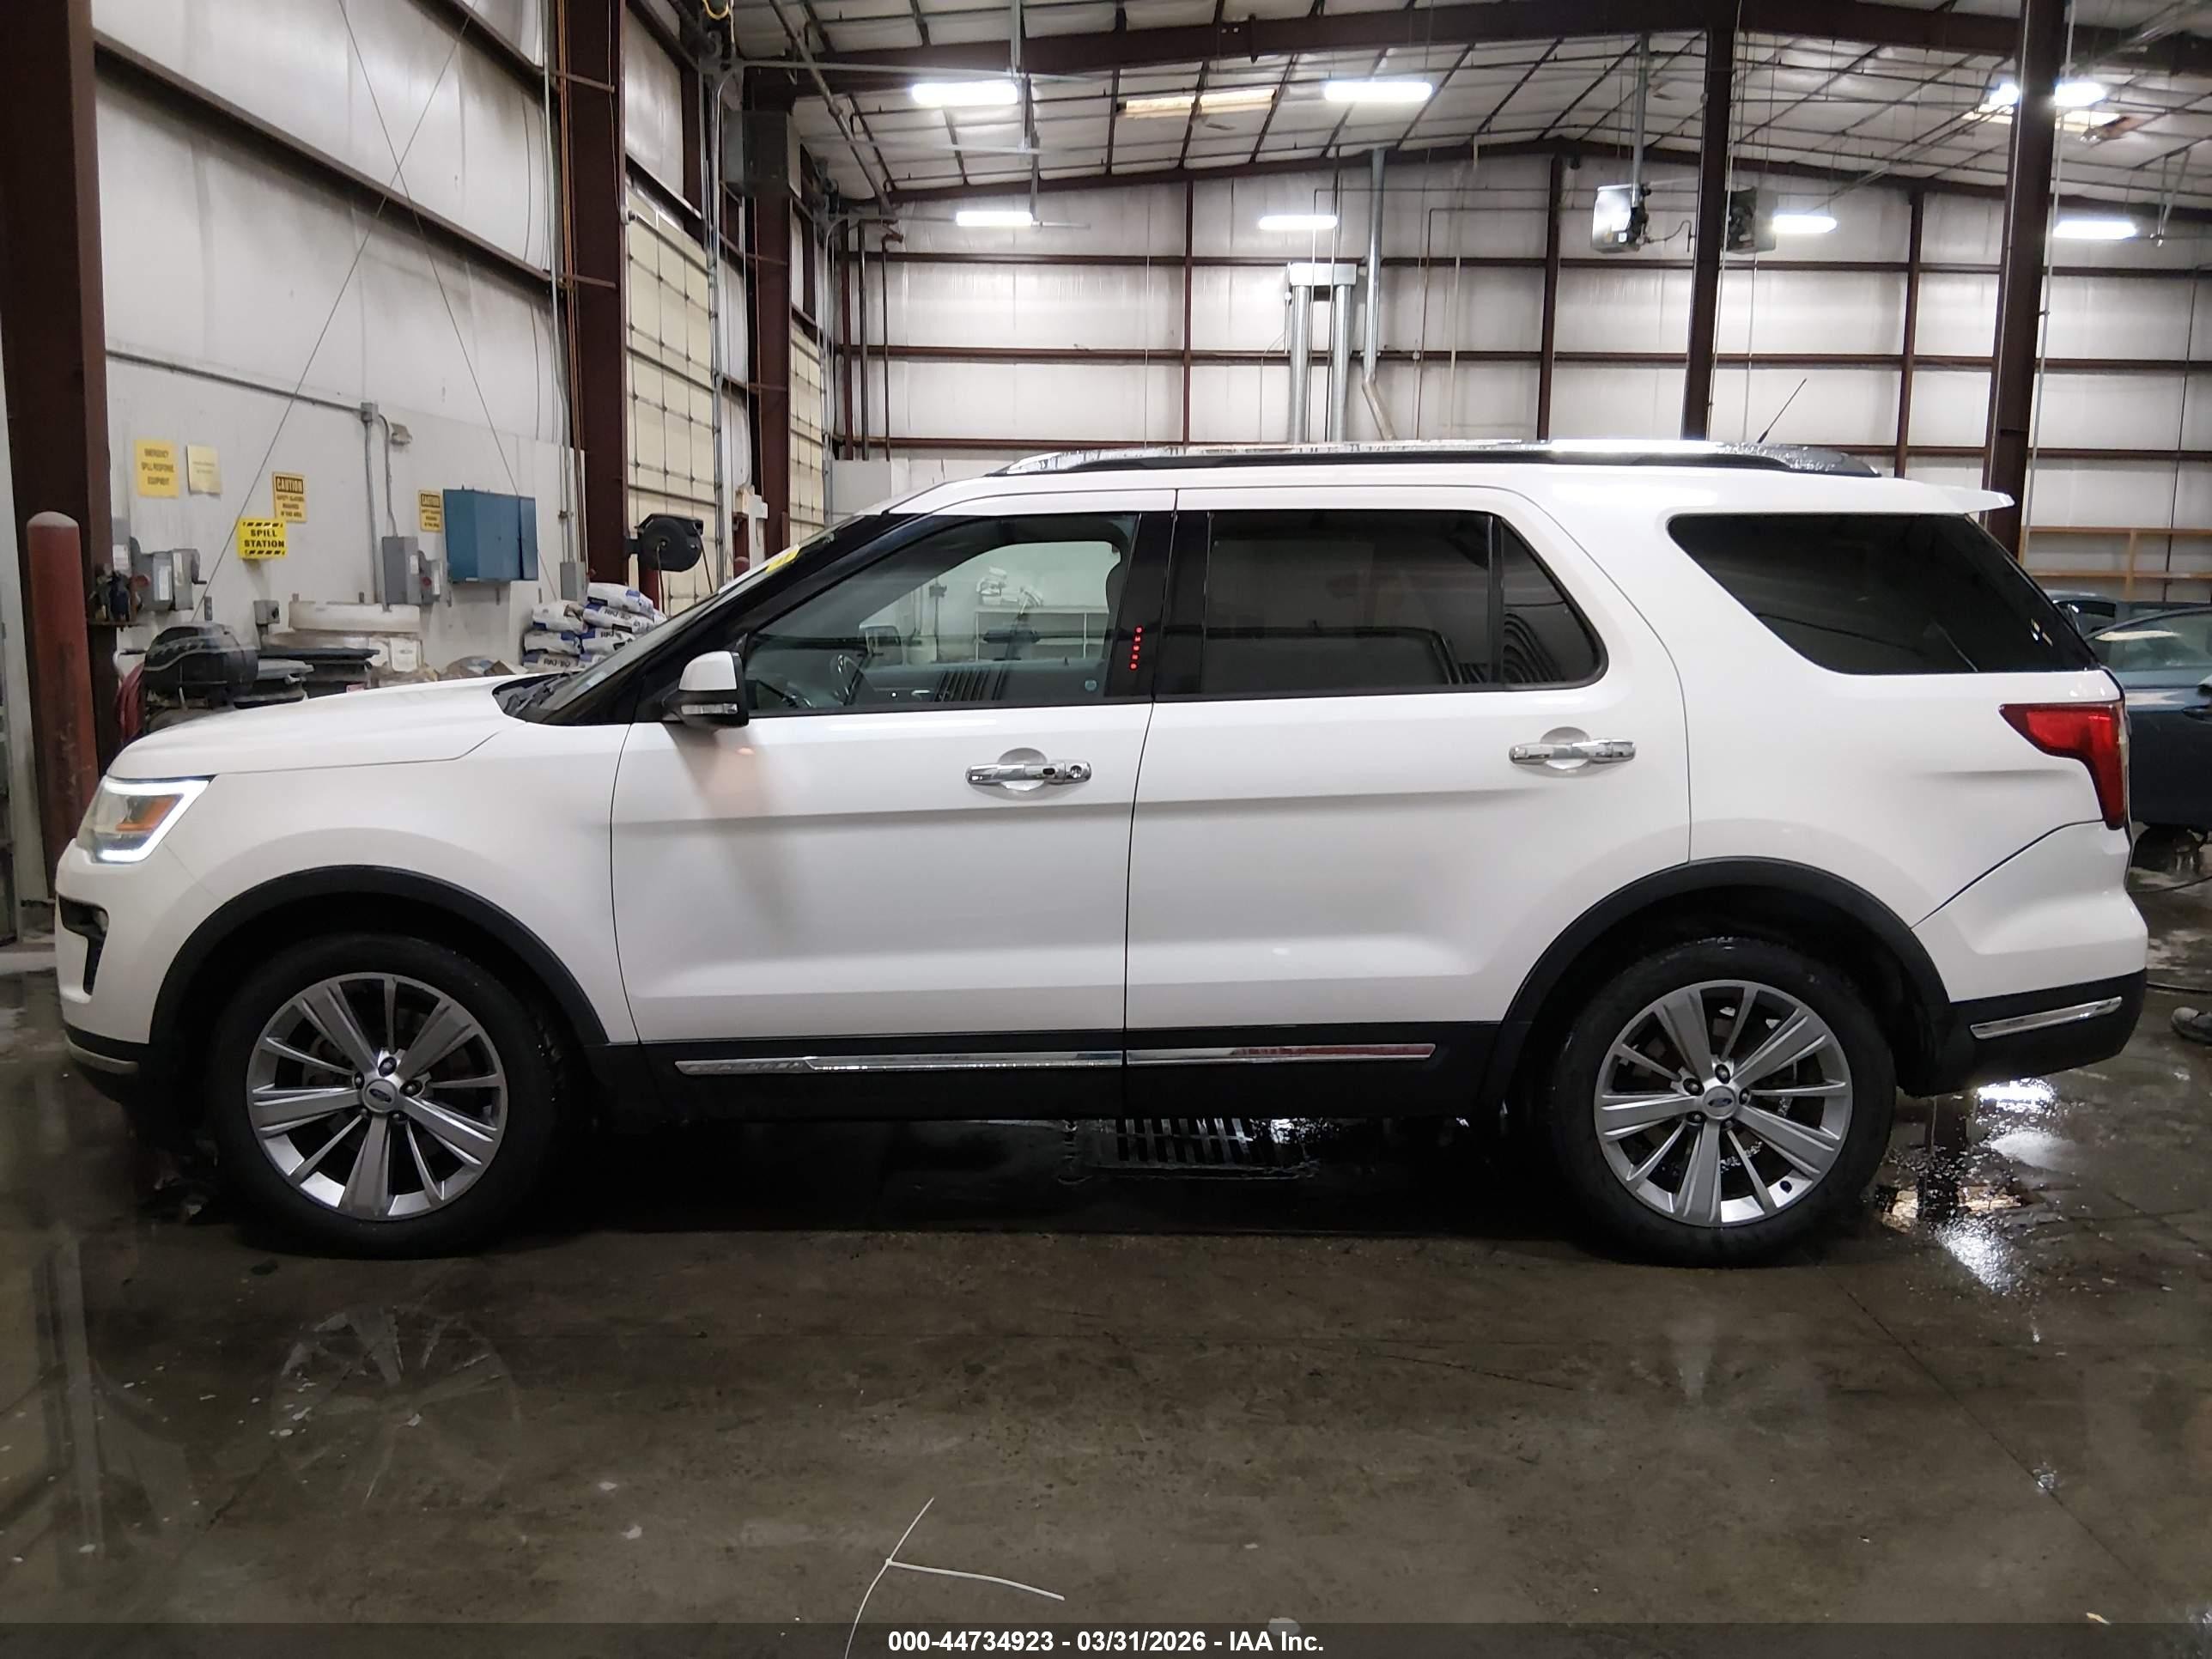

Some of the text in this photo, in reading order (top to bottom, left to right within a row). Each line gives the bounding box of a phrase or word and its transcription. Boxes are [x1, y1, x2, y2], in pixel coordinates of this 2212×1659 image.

[276, 477, 303, 493] CAUTION
[251, 529, 276, 538] SPILL
[244, 539, 285, 548] STATION
